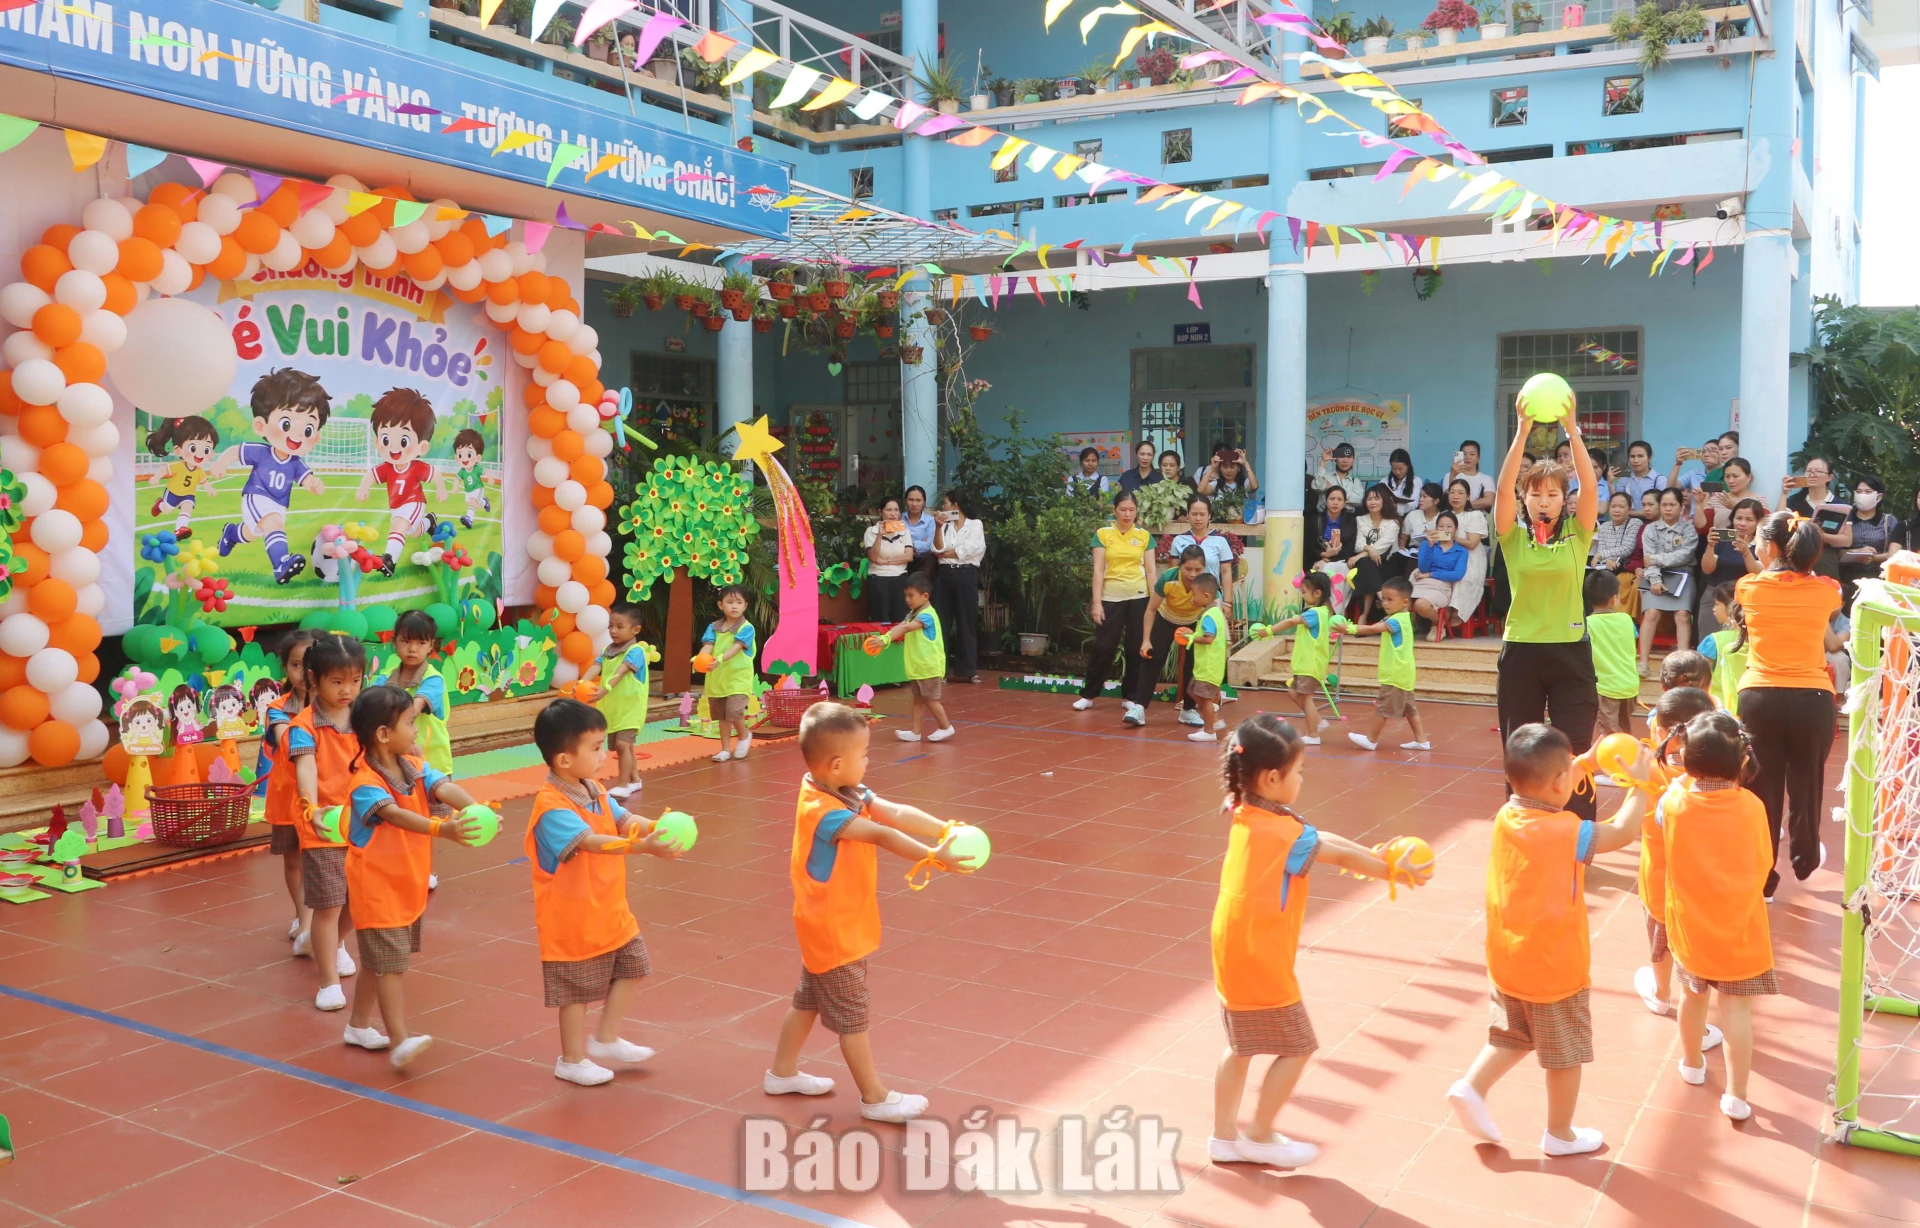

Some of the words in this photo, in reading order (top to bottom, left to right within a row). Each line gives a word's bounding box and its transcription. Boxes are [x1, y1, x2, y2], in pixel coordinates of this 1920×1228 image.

[129, 11, 219, 81] NON
[231, 37, 331, 108] VỮNG
[343, 67, 430, 133] VÀNG
[461, 101, 553, 163] TƯƠNG
[605, 138, 667, 191] VỮNG
[673, 156, 736, 208] CHẮC!
[232, 304, 263, 360] é
[266, 304, 350, 357] Vui
[361, 311, 472, 387] Khỏe
[183, 474, 192, 488] 5
[268, 470, 285, 490] 10
[395, 479, 406, 495] 7
[467, 473, 474, 486] 9
